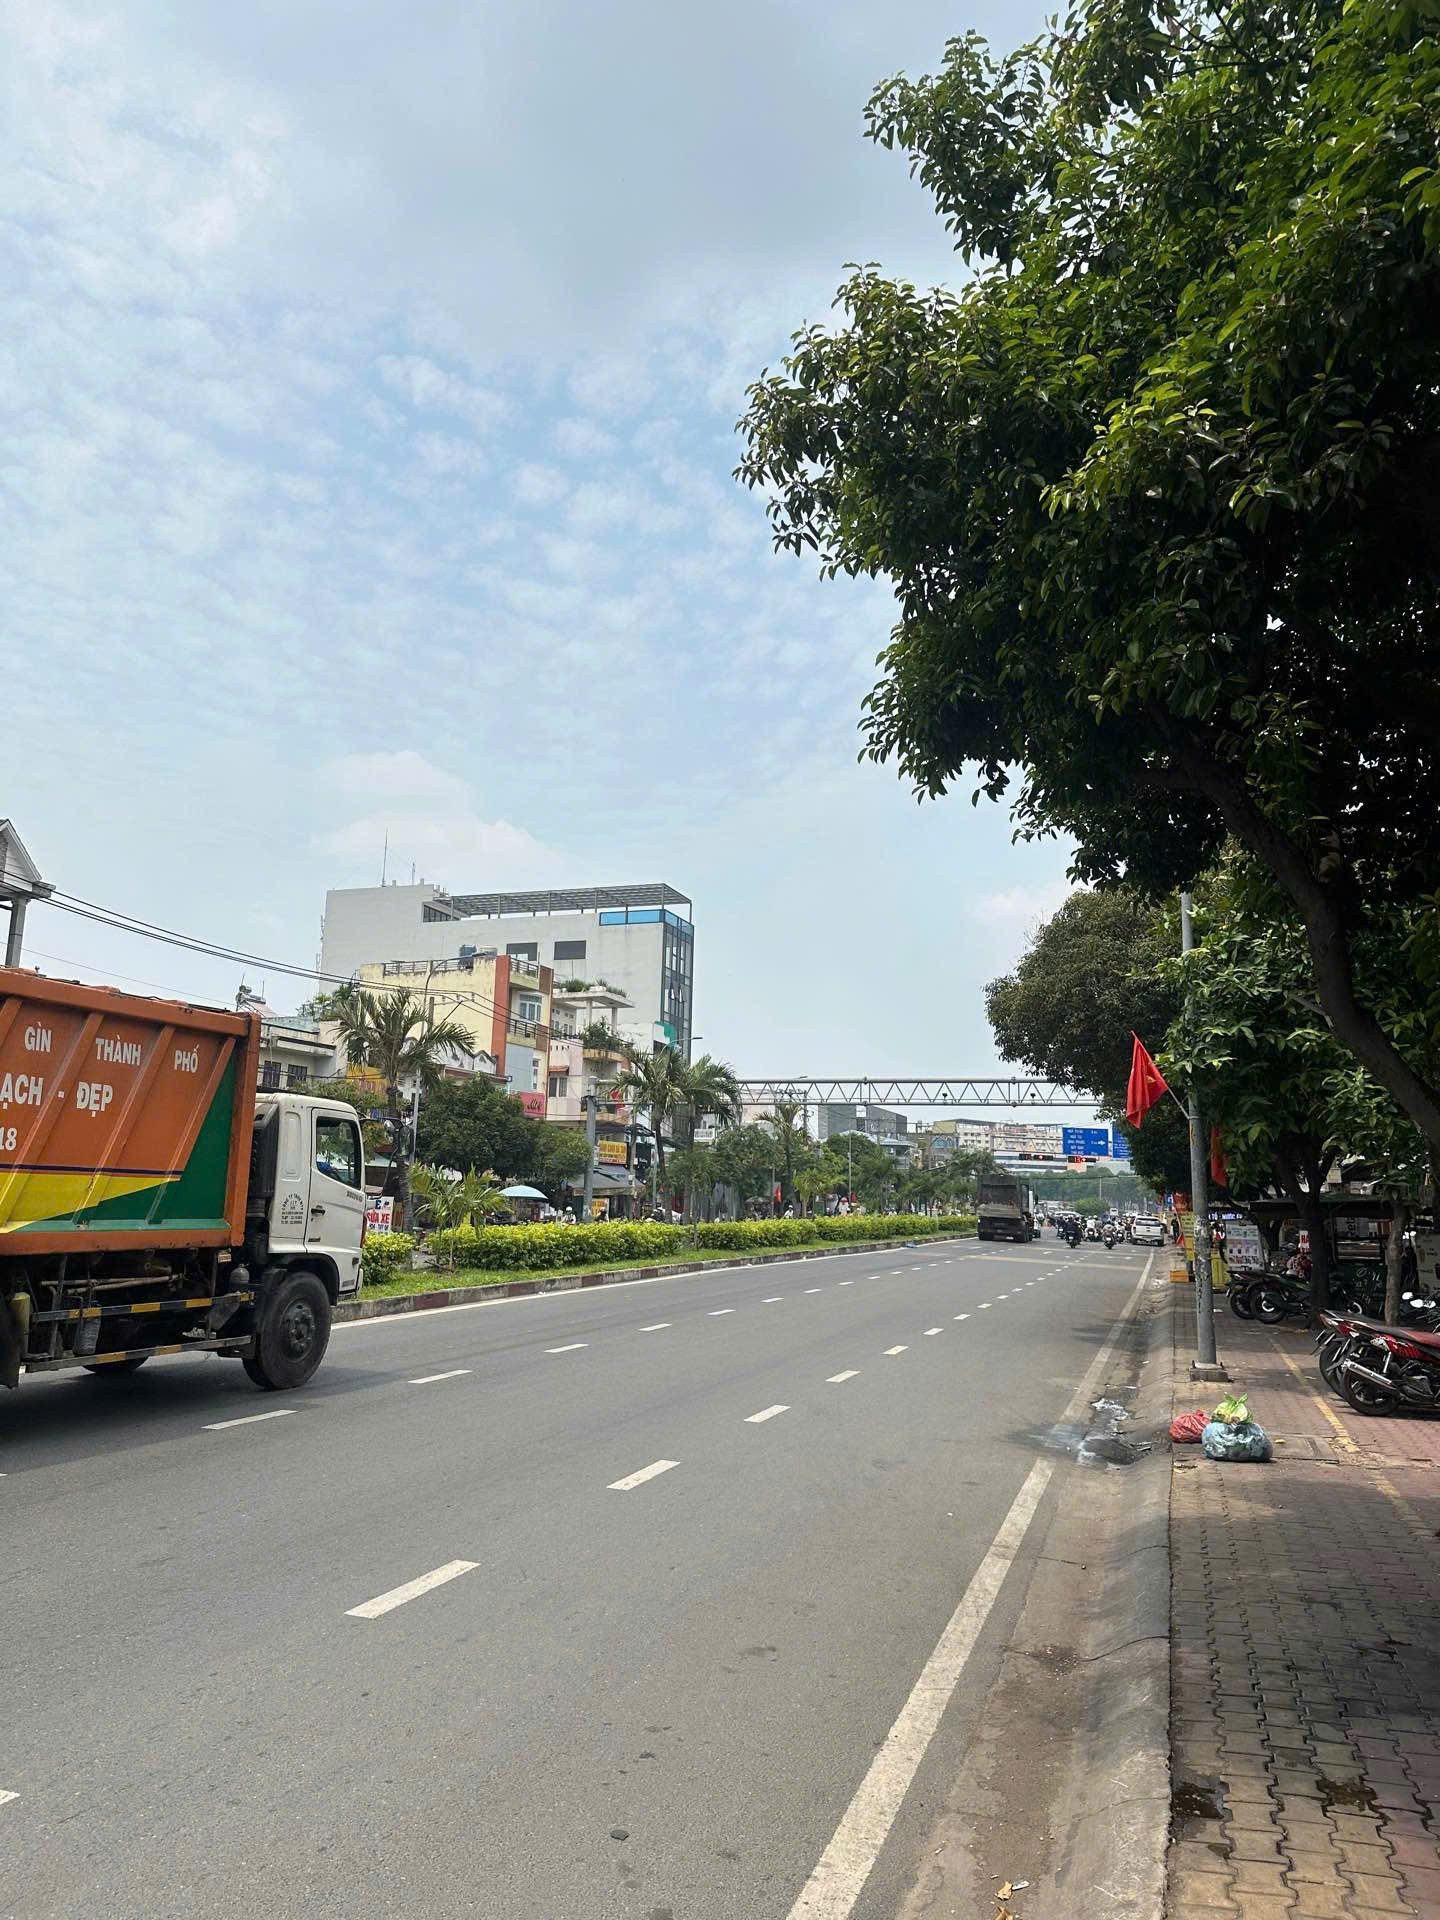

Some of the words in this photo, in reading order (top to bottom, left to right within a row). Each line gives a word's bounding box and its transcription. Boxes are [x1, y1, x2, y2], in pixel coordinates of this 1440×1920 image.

[24, 1021, 52, 1053] GÌN
[95, 1034, 142, 1066] THÀNH
[173, 1044, 200, 1073] PHỐ
[76, 1081, 113, 1118] ĐẸP
[380, 1213, 390, 1224] XE
